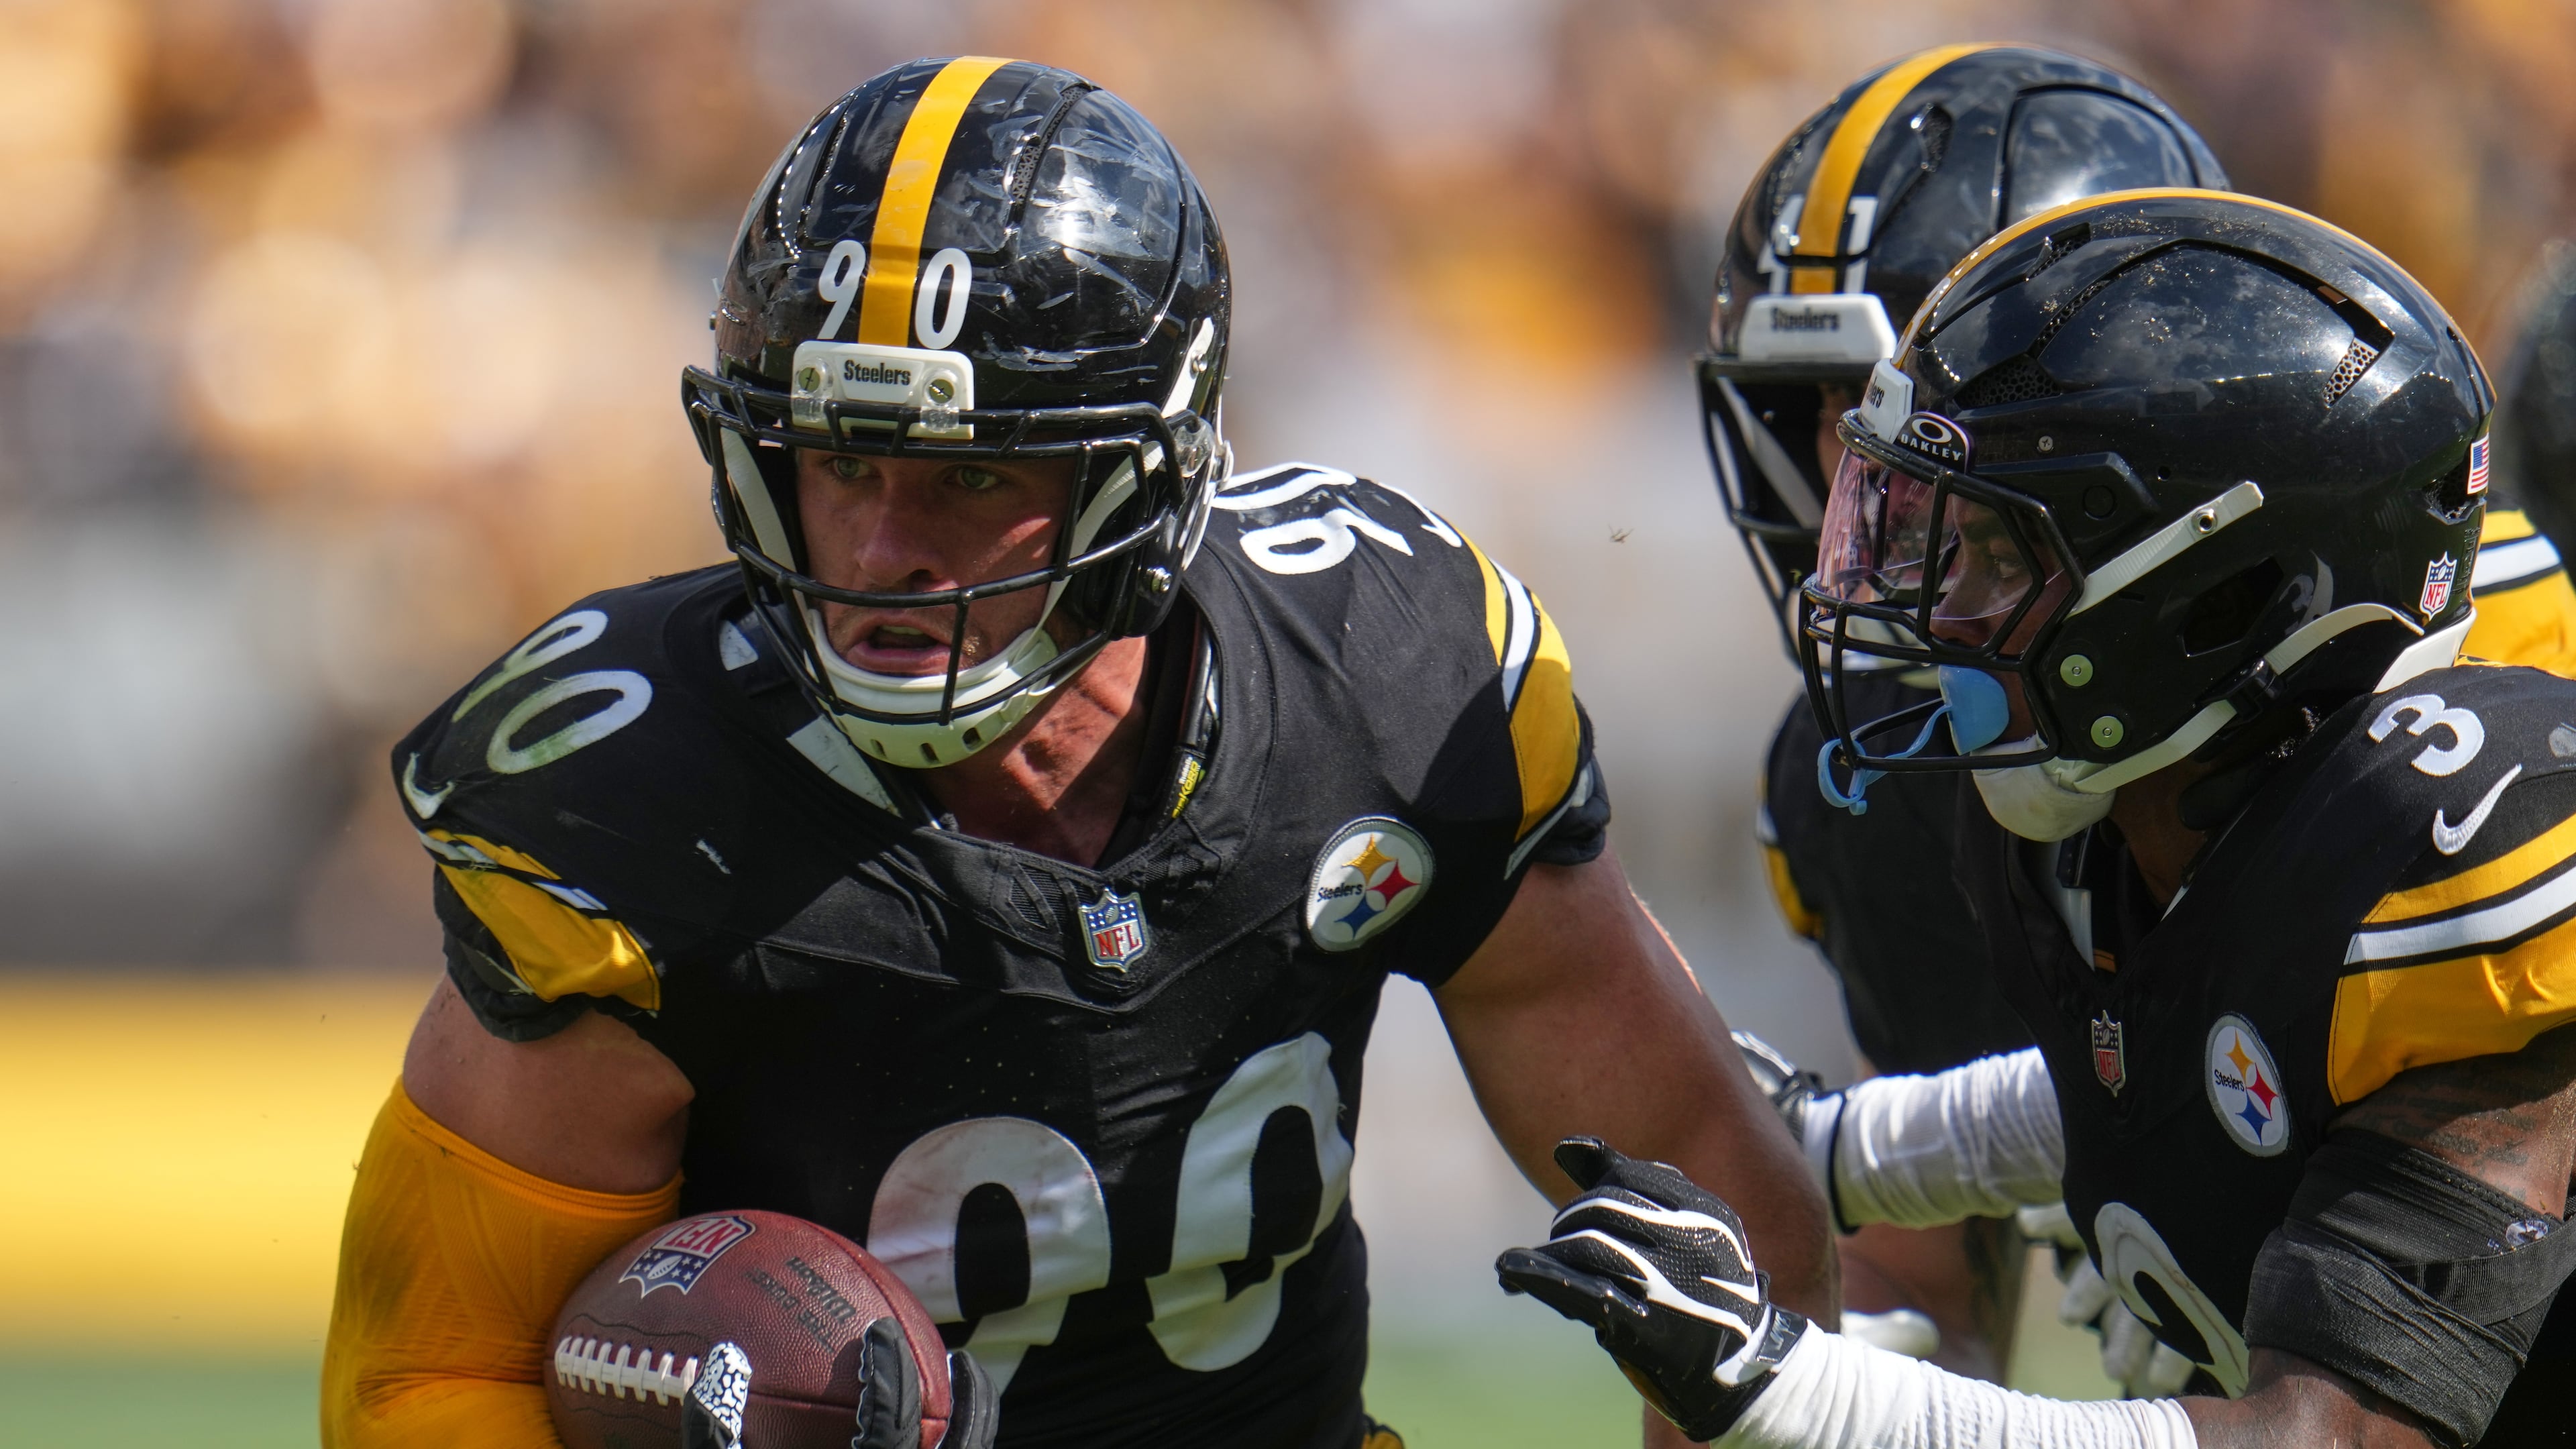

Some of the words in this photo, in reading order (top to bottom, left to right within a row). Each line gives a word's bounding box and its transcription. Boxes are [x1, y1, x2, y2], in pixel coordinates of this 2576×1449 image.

[816, 239, 972, 350] 90
[1770, 306, 1840, 332] Steelers
[843, 359, 912, 386] Steelers
[1900, 433, 1962, 462] OAKLEY
[2424, 583, 2447, 608] NFL
[451, 610, 653, 775] 90
[2367, 693, 2485, 777] 3
[1317, 882, 1363, 903] Steelers
[1096, 924, 1140, 957] NFL
[2096, 1051, 2121, 1081] NFL
[2214, 1069, 2245, 1092] Steelers
[866, 1031, 1354, 1397] 90
[665, 1218, 742, 1255] NFL
[785, 1256, 857, 1324] Wilson
